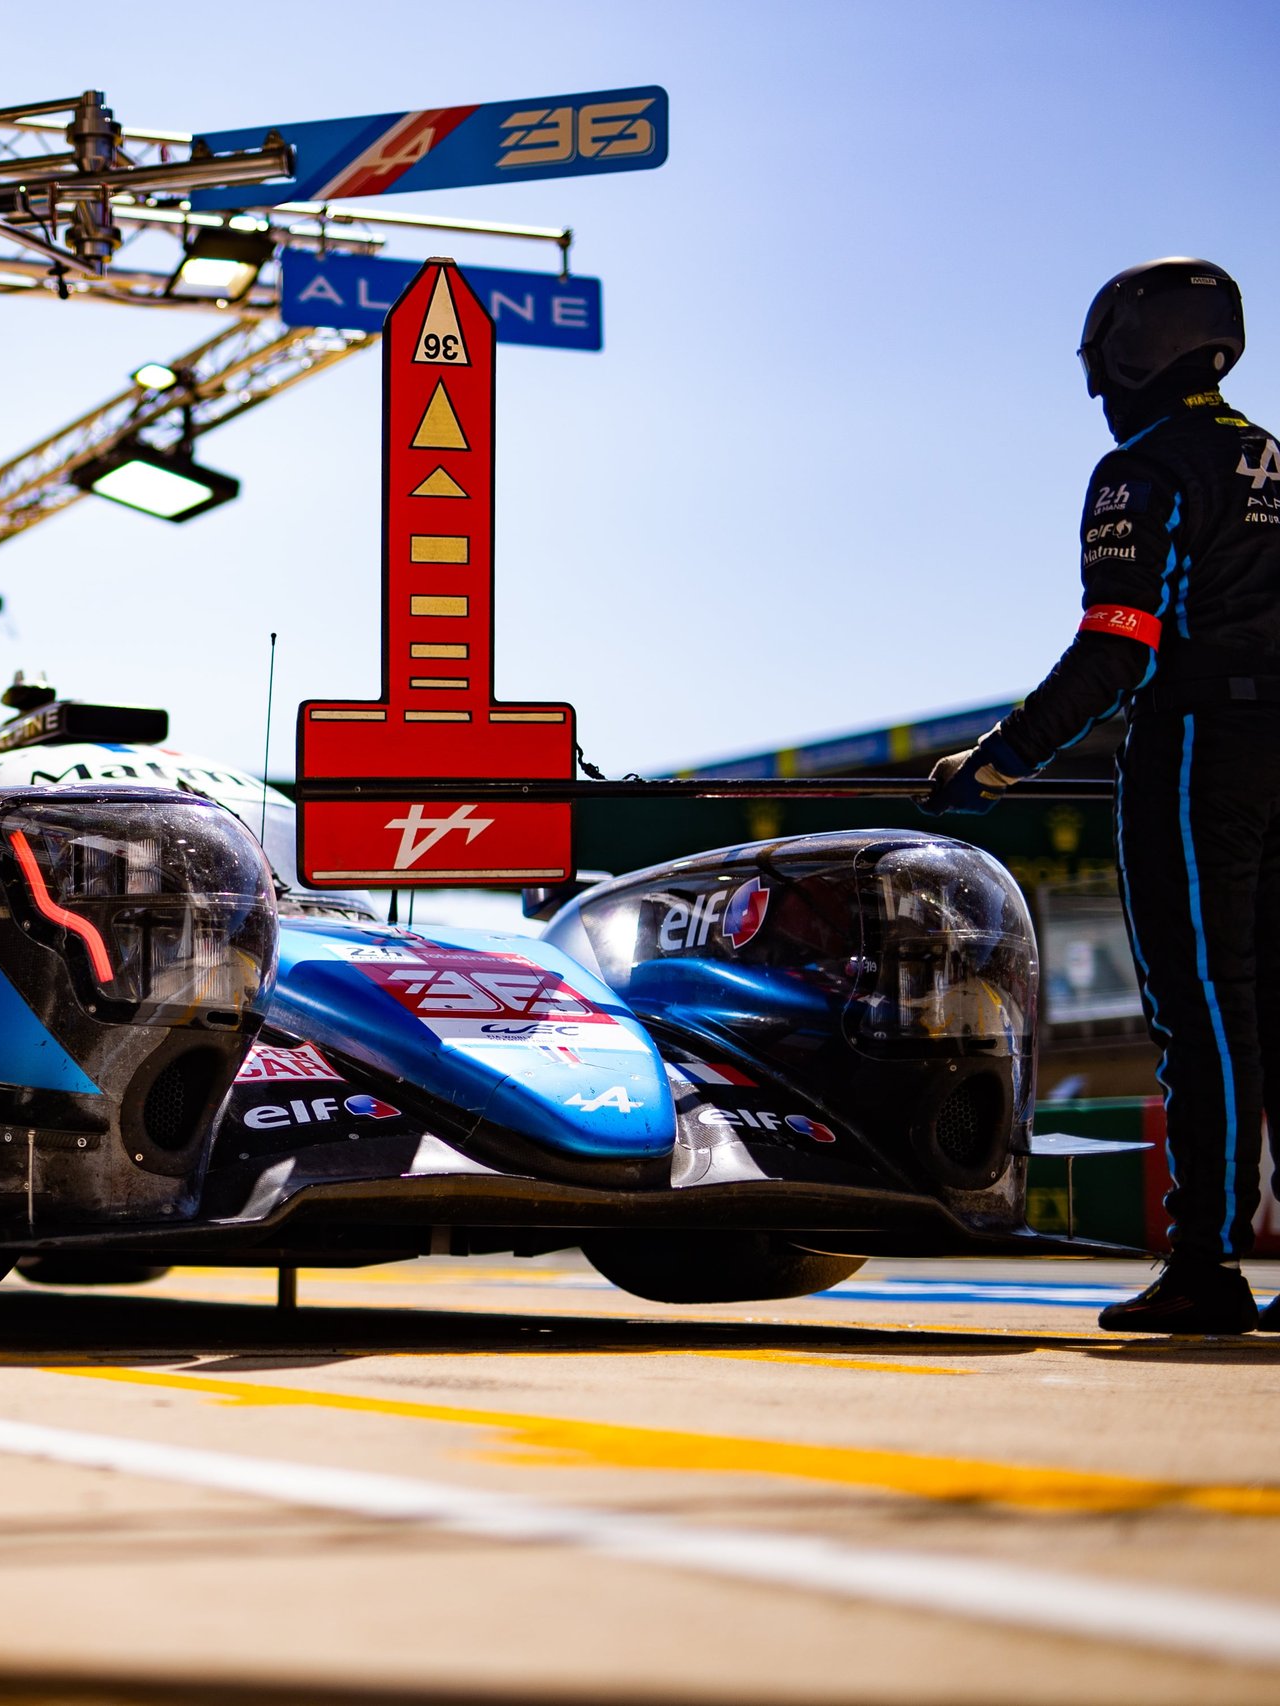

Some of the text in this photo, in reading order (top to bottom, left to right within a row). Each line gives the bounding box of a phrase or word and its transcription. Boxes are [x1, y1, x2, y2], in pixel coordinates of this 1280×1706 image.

[496, 98, 657, 168] 36
[298, 276, 589, 328] ALNE
[424, 333, 459, 360] 36
[1095, 483, 1130, 508] 24h
[1086, 523, 1114, 543] elf
[1083, 545, 1136, 566] Matmut
[1110, 610, 1137, 627] 24h
[659, 889, 727, 950] elf
[387, 969, 593, 1017] 36
[481, 1024, 579, 1036] WEC
[243, 1097, 339, 1129] elf
[698, 1108, 782, 1131] elf
